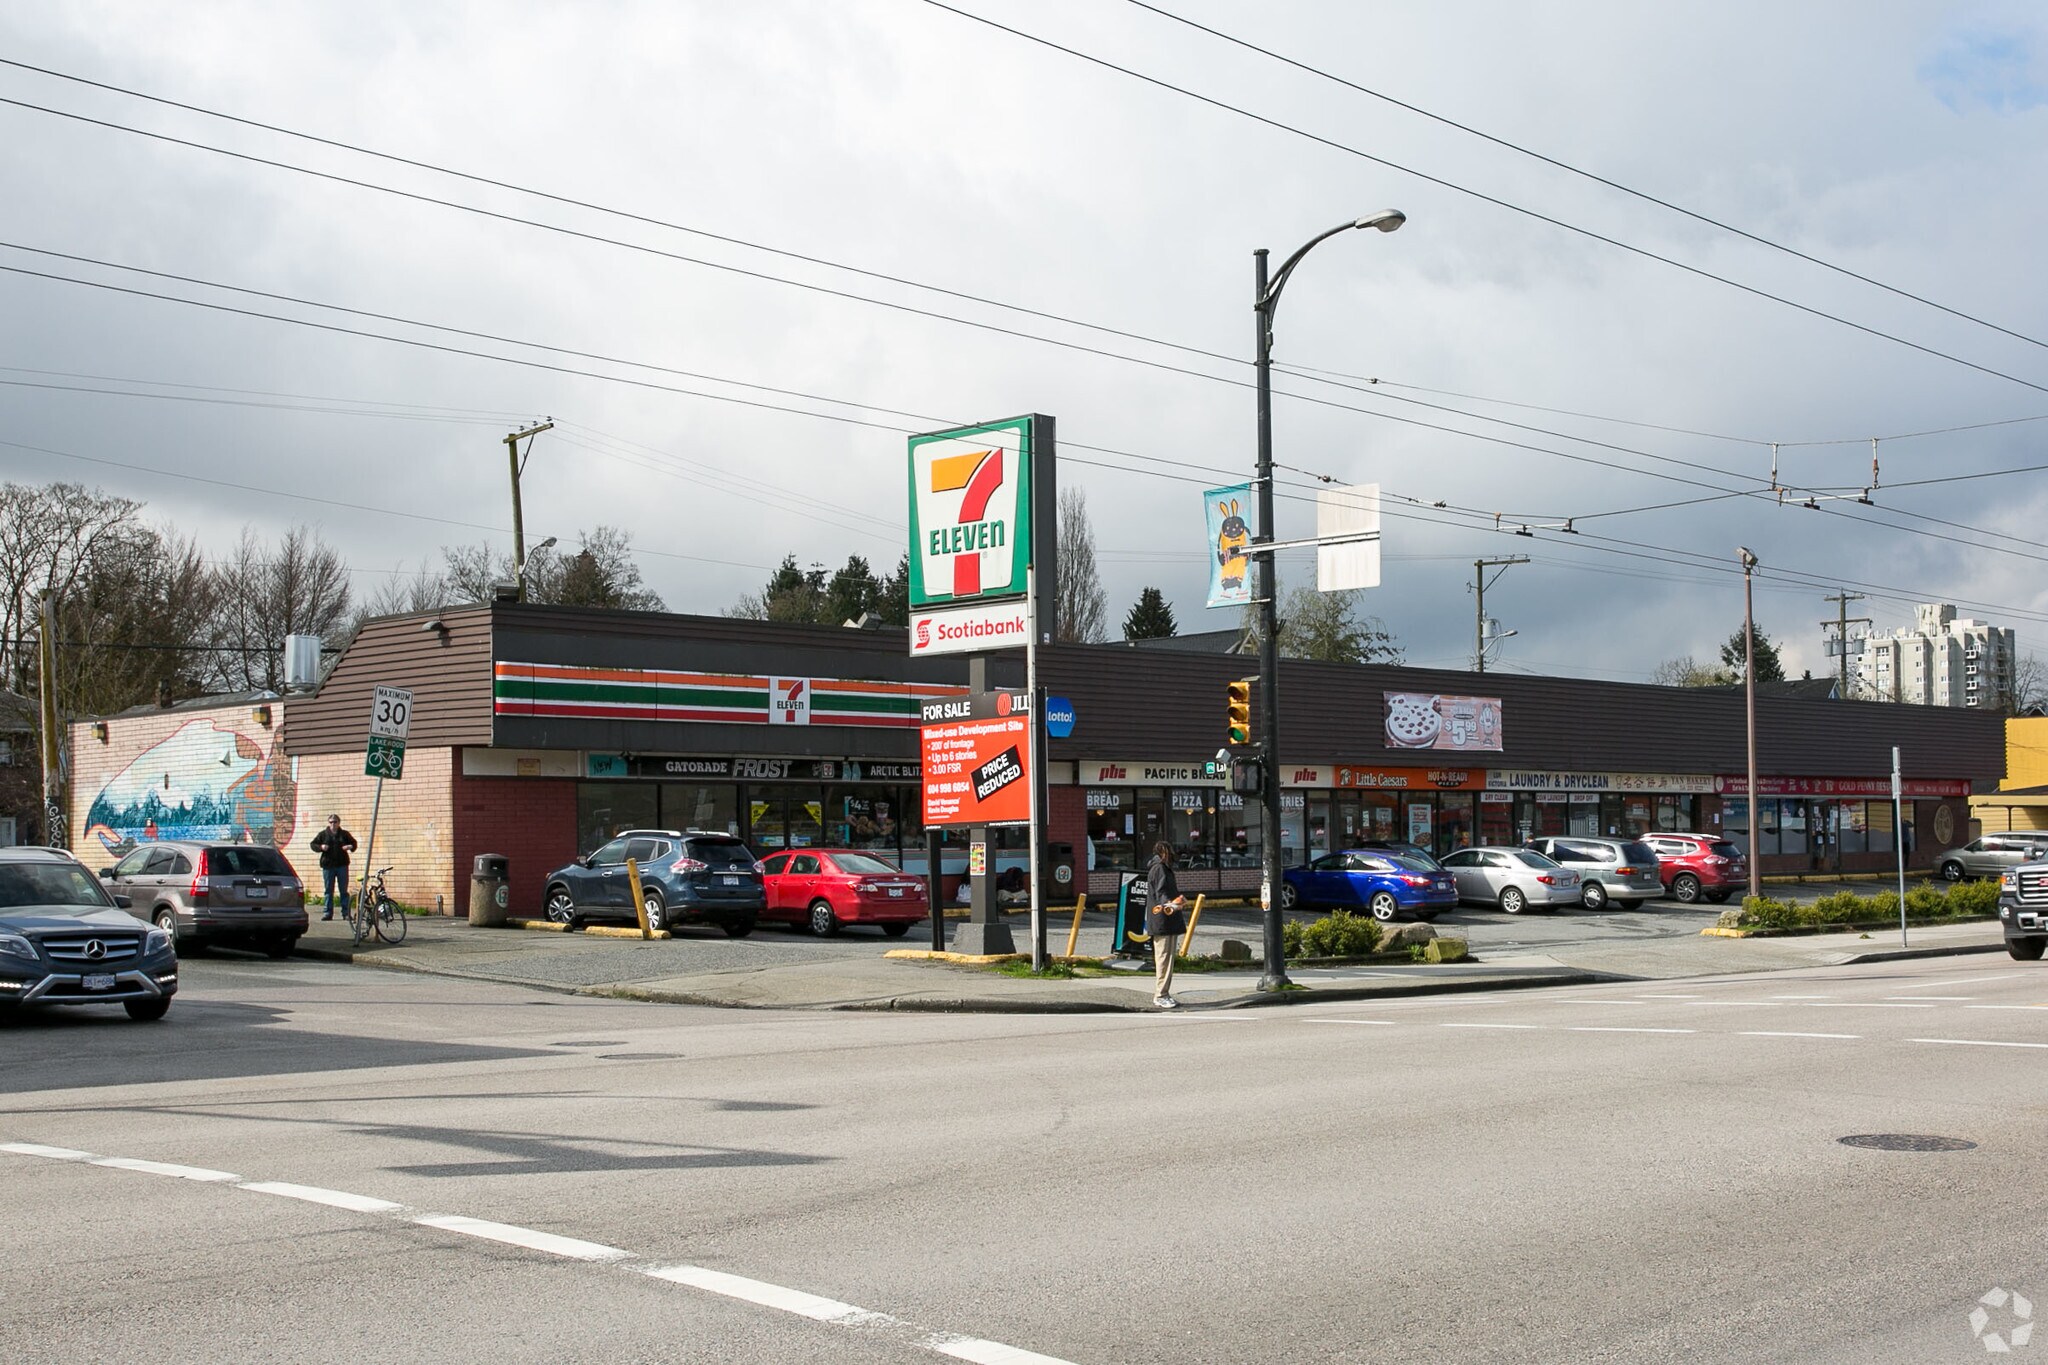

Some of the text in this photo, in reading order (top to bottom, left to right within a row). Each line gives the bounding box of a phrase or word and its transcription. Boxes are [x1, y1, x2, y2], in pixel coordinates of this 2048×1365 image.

[938, 616, 1025, 640] Scotiabank
[378, 688, 410, 701] MAXIMUM
[377, 700, 406, 725] 30
[923, 701, 971, 720] FOR SALE
[958, 723, 1006, 736] Development
[1007, 720, 1024, 731] Site
[370, 737, 405, 749] LAKEWOOD
[932, 753, 941, 764] Up
[942, 752, 949, 761] to
[666, 761, 728, 773] GATORADE
[732, 758, 793, 778] FROST
[870, 765, 900, 776] ARCTIC
[932, 763, 962, 775] 3.00 FSR
[981, 754, 1009, 779] PRICE
[1144, 767, 1188, 779] PACIFIC
[1427, 771, 1469, 782] HOT-N-READY
[977, 764, 1021, 798] REDUCED
[1355, 772, 1408, 787] Little Caesars
[1509, 773, 1609, 788] LAUNDRY & DRYCLEAN
[1686, 776, 1711, 785] BAKERY
[1839, 780, 1856, 791] GOLD
[1086, 795, 1120, 806] BREAD
[1172, 795, 1203, 807] PIZZA
[1219, 795, 1243, 806] CAKE
